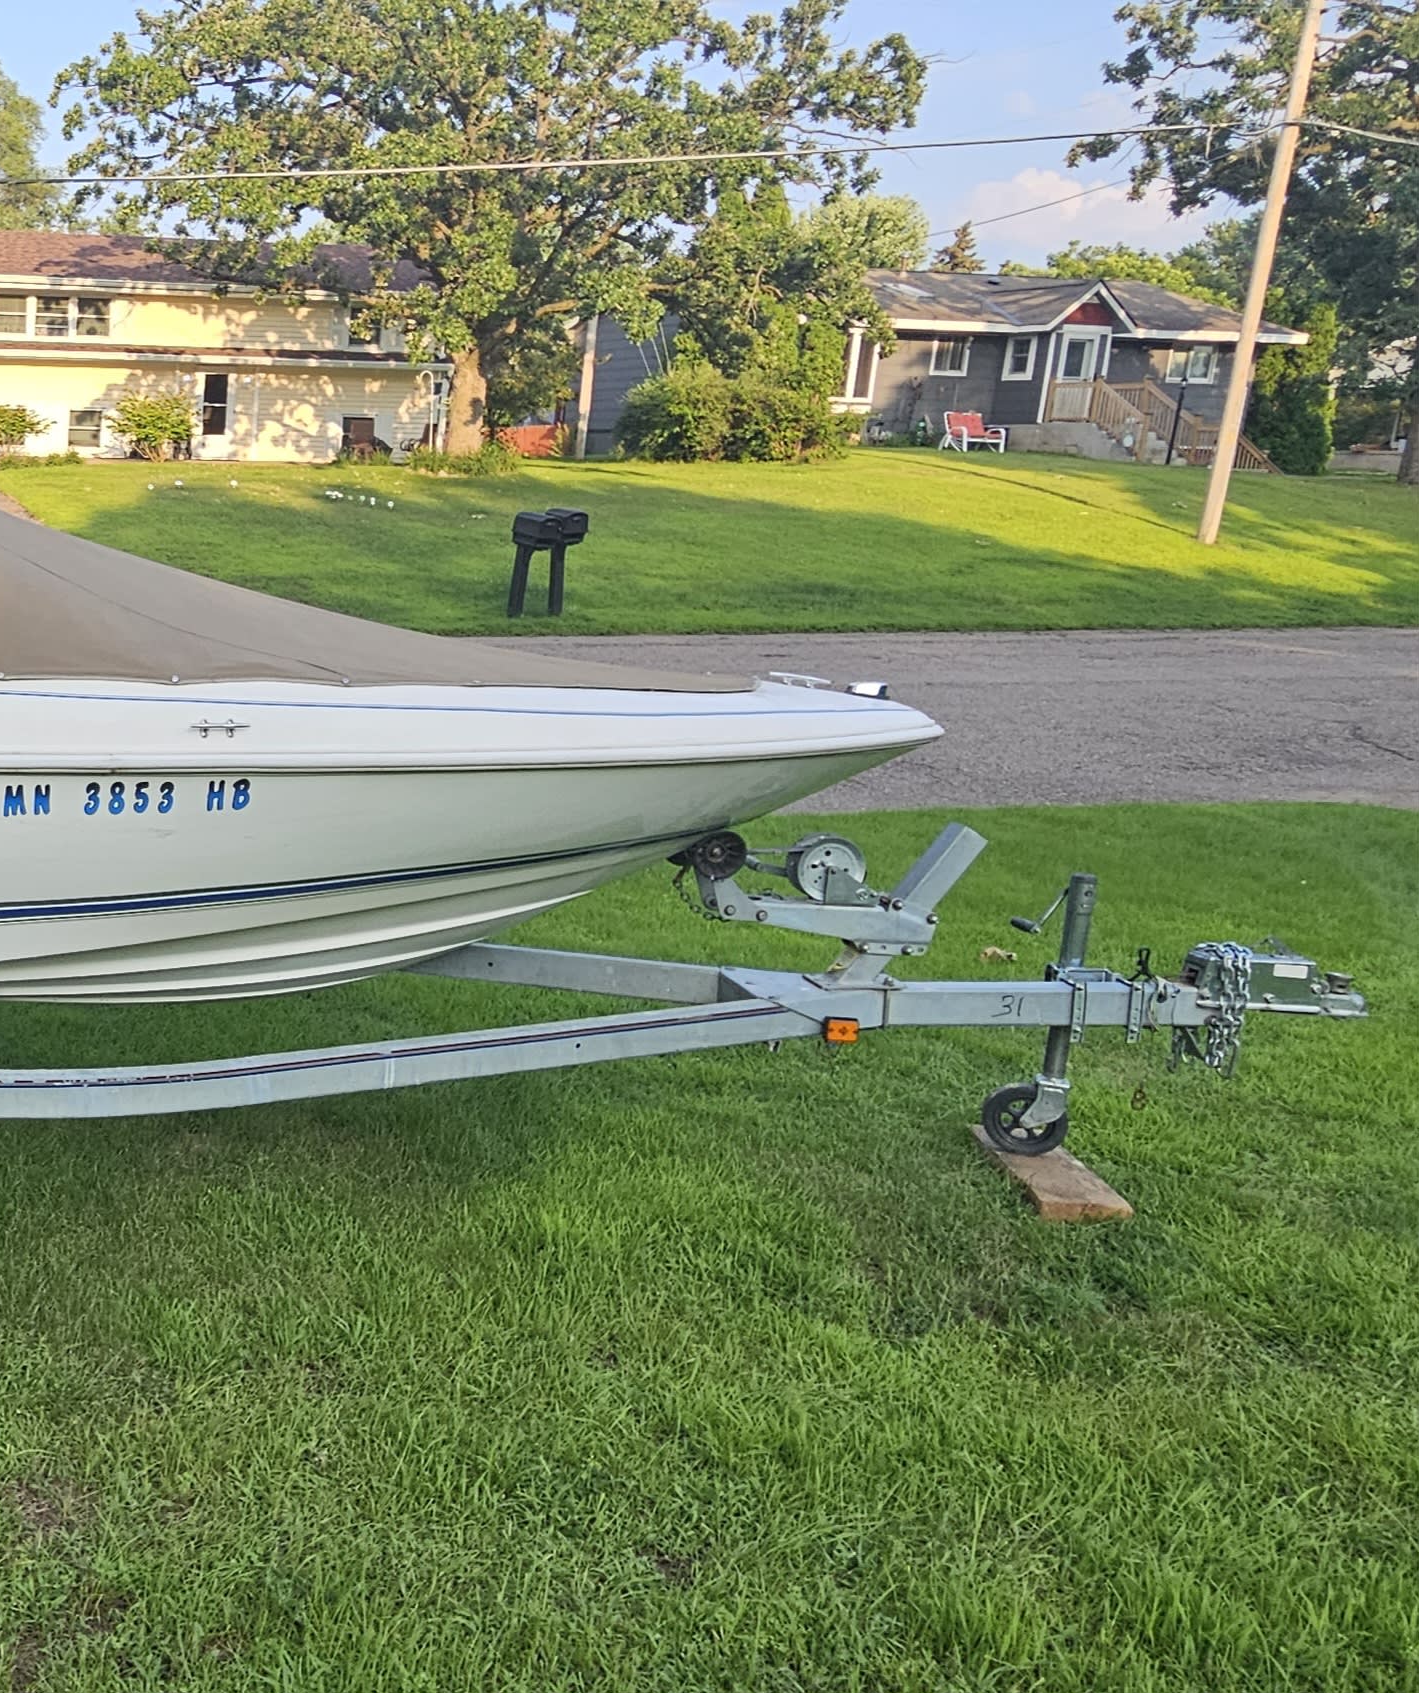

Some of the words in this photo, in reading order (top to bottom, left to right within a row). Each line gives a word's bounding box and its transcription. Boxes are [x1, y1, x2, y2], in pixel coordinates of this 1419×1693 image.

[3, 784, 51, 817] MN
[83, 781, 175, 815] 3853
[206, 778, 251, 812] HB
[991, 994, 1025, 1018] 31
